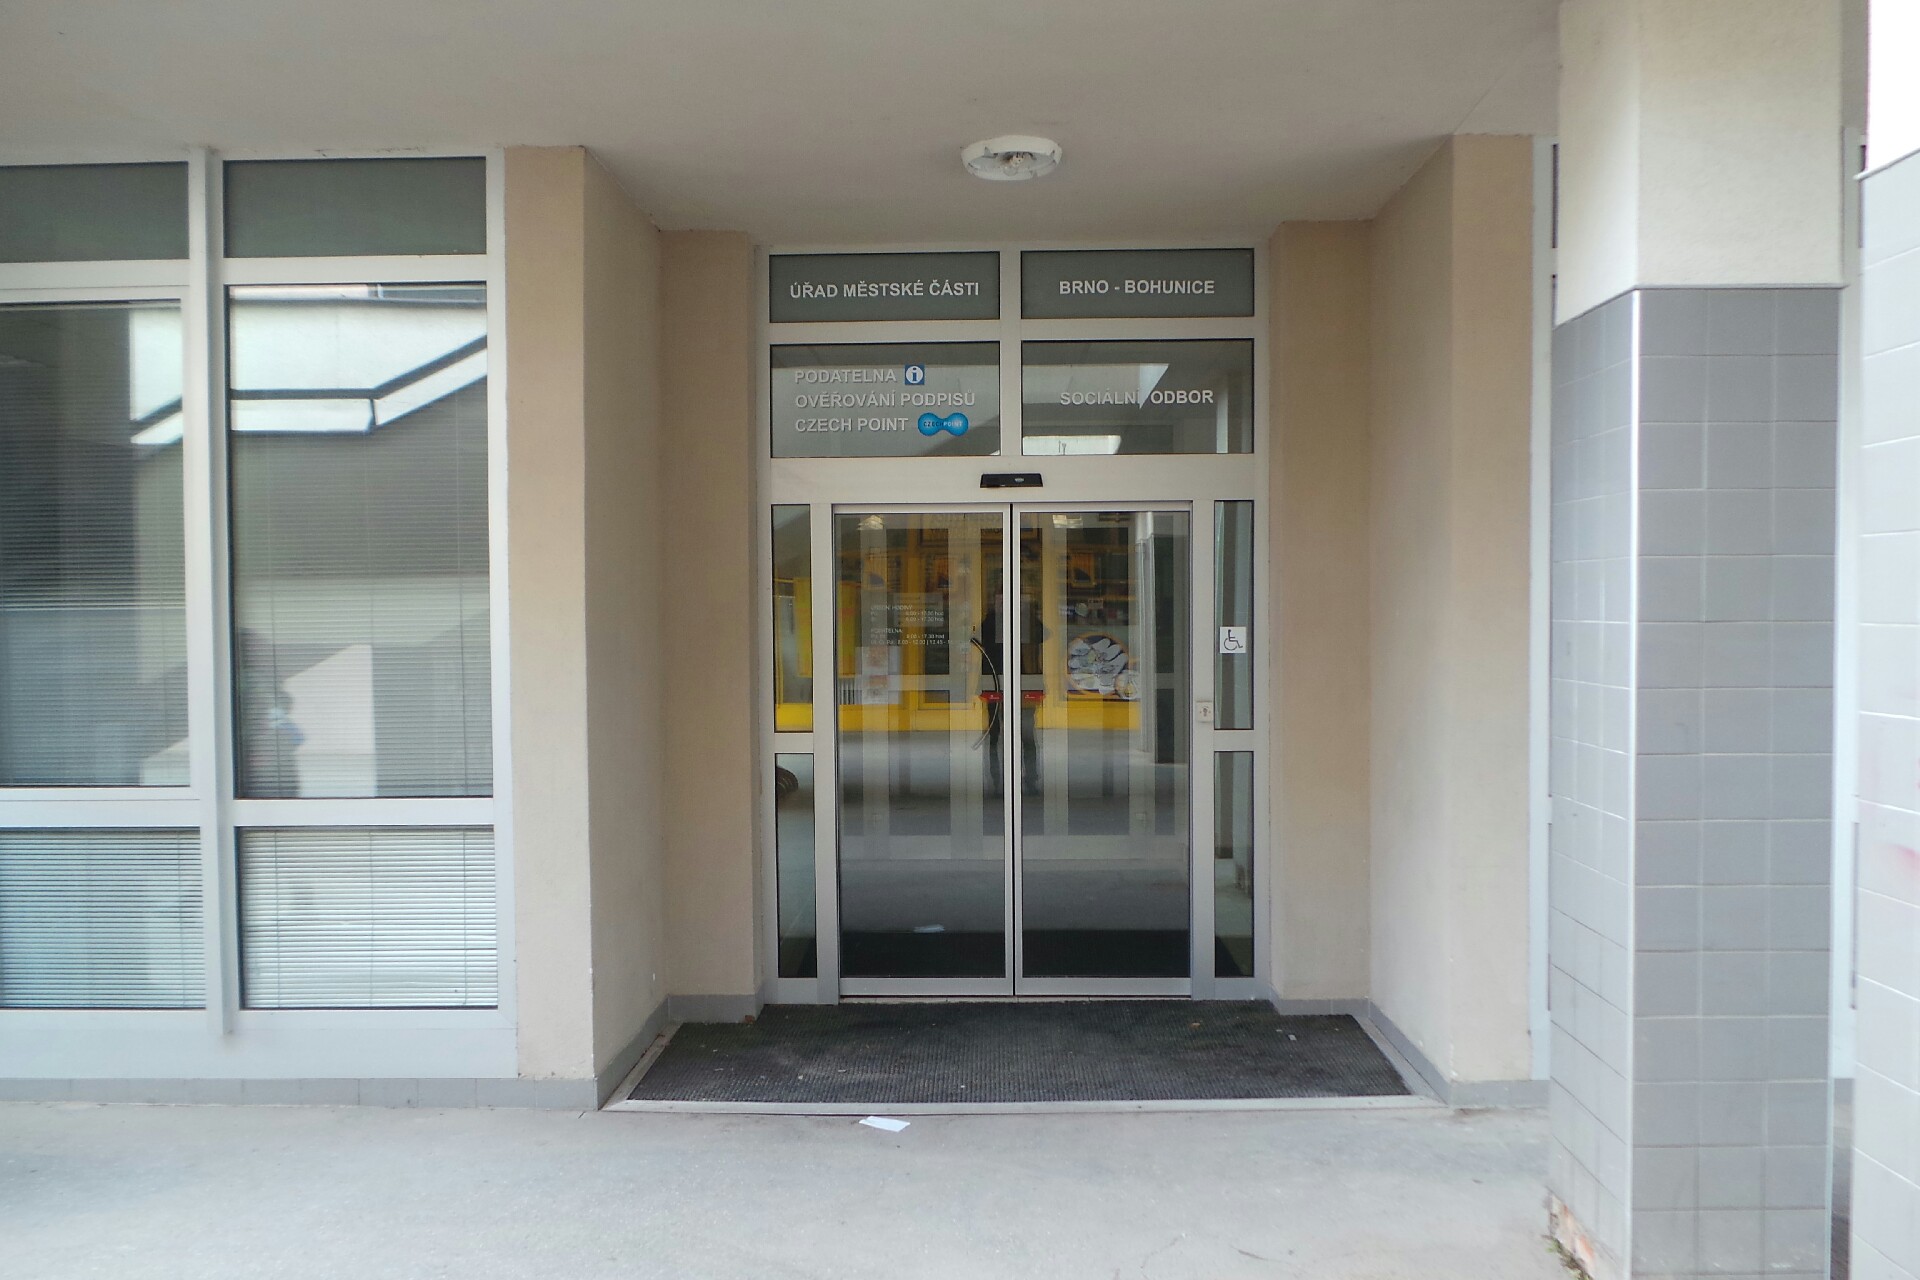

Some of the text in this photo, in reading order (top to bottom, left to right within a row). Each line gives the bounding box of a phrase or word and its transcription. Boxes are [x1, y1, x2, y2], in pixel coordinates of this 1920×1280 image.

[790, 279, 979, 298] ÚŘAD MĚSTSKÉ ČÁSTI
[1059, 280, 1109, 294] BRNO
[1124, 280, 1215, 294] BOHUNICE
[794, 368, 897, 384] PODATELNA
[795, 389, 975, 408] OVĚŘOVÁNÍ PODPISŮ
[1060, 388, 1214, 405] SOCIÁLNÍ ODBOR
[795, 417, 908, 432] CZECH POINT
